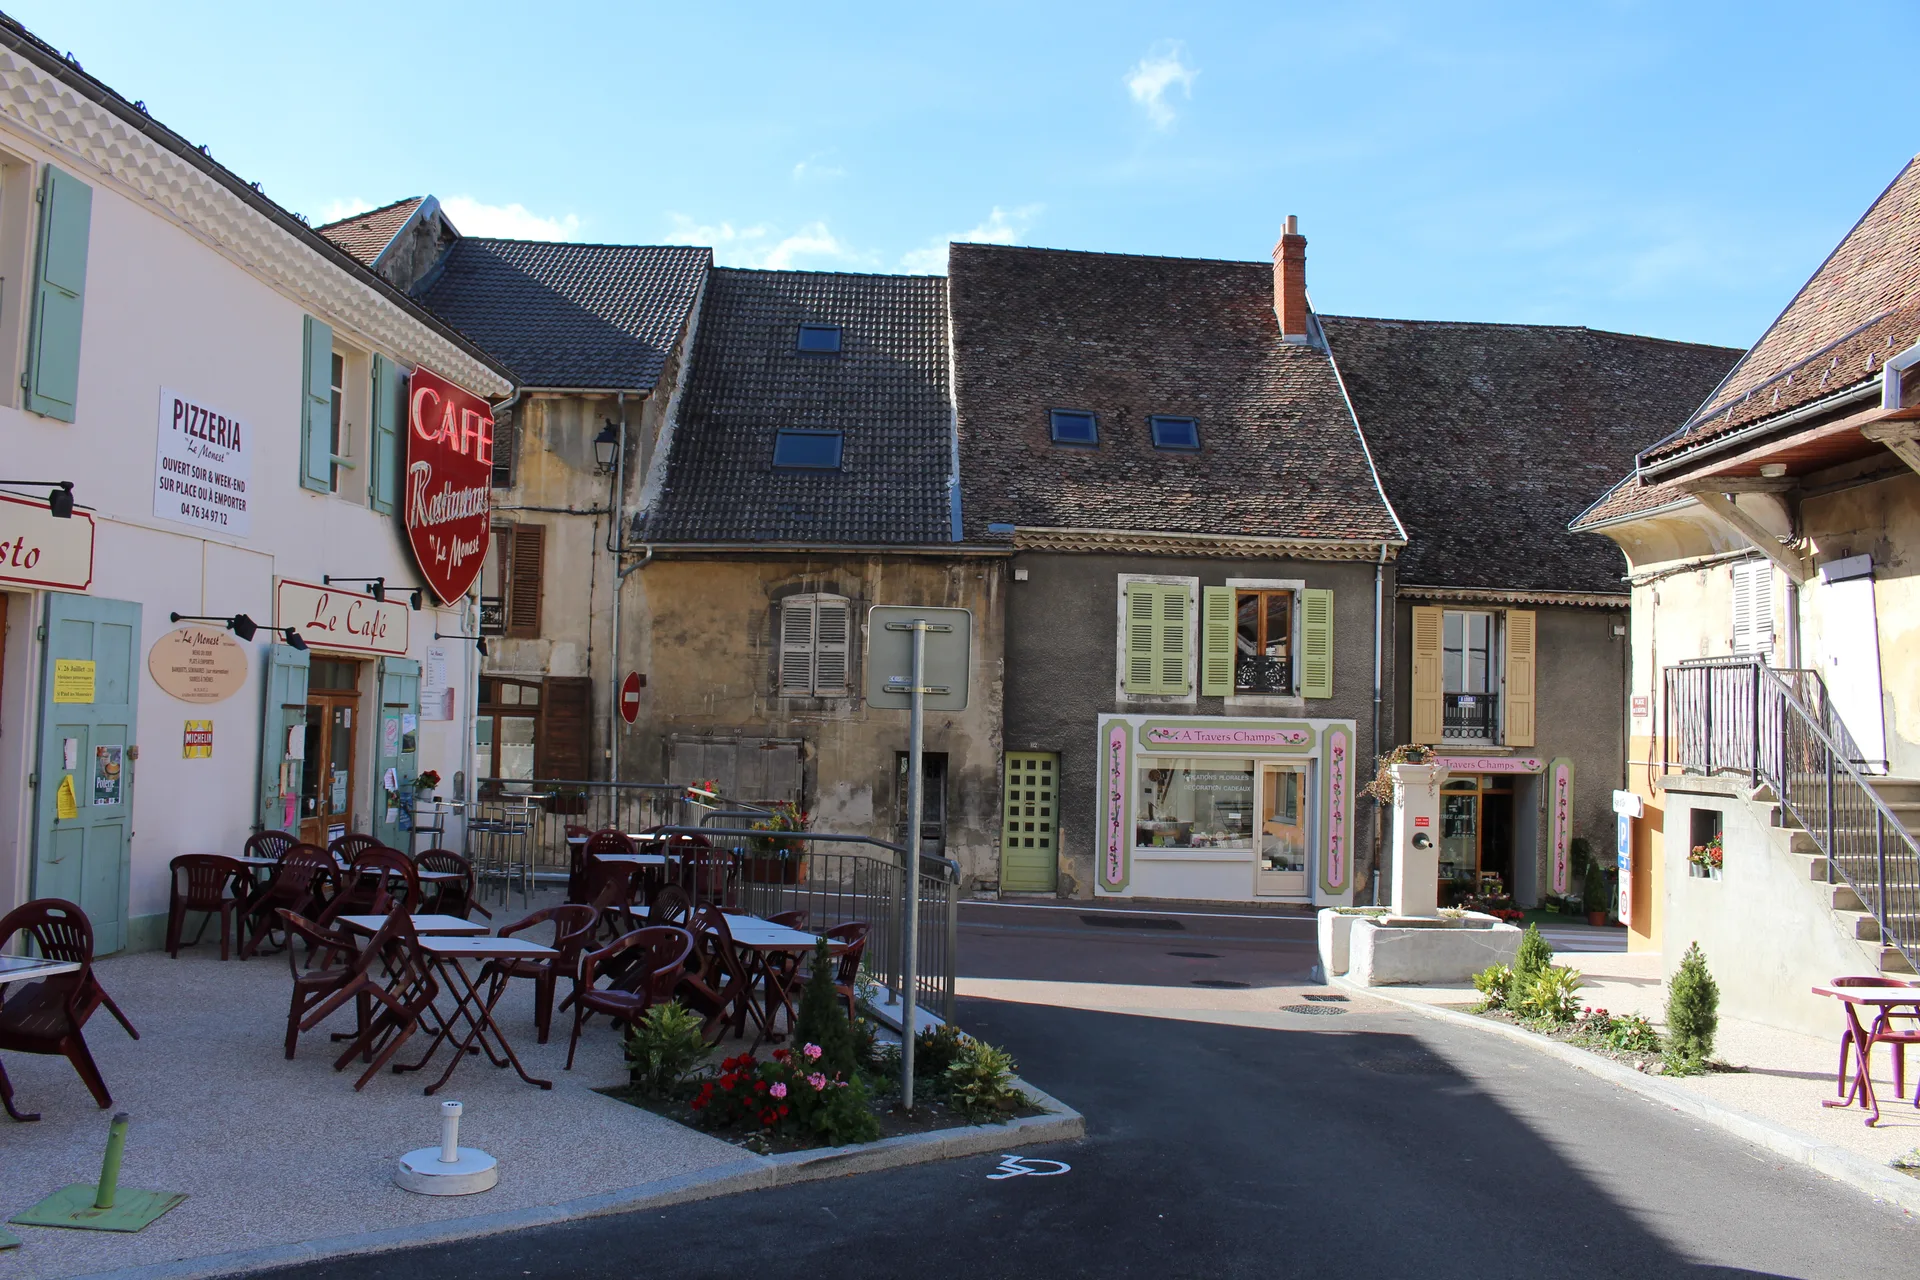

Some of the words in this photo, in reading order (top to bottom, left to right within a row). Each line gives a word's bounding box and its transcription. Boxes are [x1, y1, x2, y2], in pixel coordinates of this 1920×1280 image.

[172, 399, 241, 452] PIZZERIA
[412, 387, 495, 466] CAFE
[162, 457, 190, 475] OUVERT
[192, 466, 206, 482] SOIR
[208, 471, 214, 482] &
[214, 472, 246, 492] WEEK-END
[160, 476, 174, 492] SUR
[176, 481, 197, 500] PLACE
[198, 487, 208, 500] OU
[208, 487, 213, 502] À
[214, 492, 246, 512] EMPORTER
[410, 460, 490, 529] Restaurant
[181, 502, 190, 516] 04
[191, 505, 200, 518] 76
[201, 508, 210, 520] 34
[210, 510, 218, 523] 97
[220, 512, 228, 526] 12
[306, 593, 336, 632] Le
[346, 600, 386, 645] Café
[186, 734, 212, 743] MICHELIN
[1182, 731, 1191, 740] A
[1194, 731, 1230, 741] Travers
[1234, 732, 1276, 743] Champs
[1444, 760, 1475, 768] Travers
[1478, 760, 1514, 770] Champs
